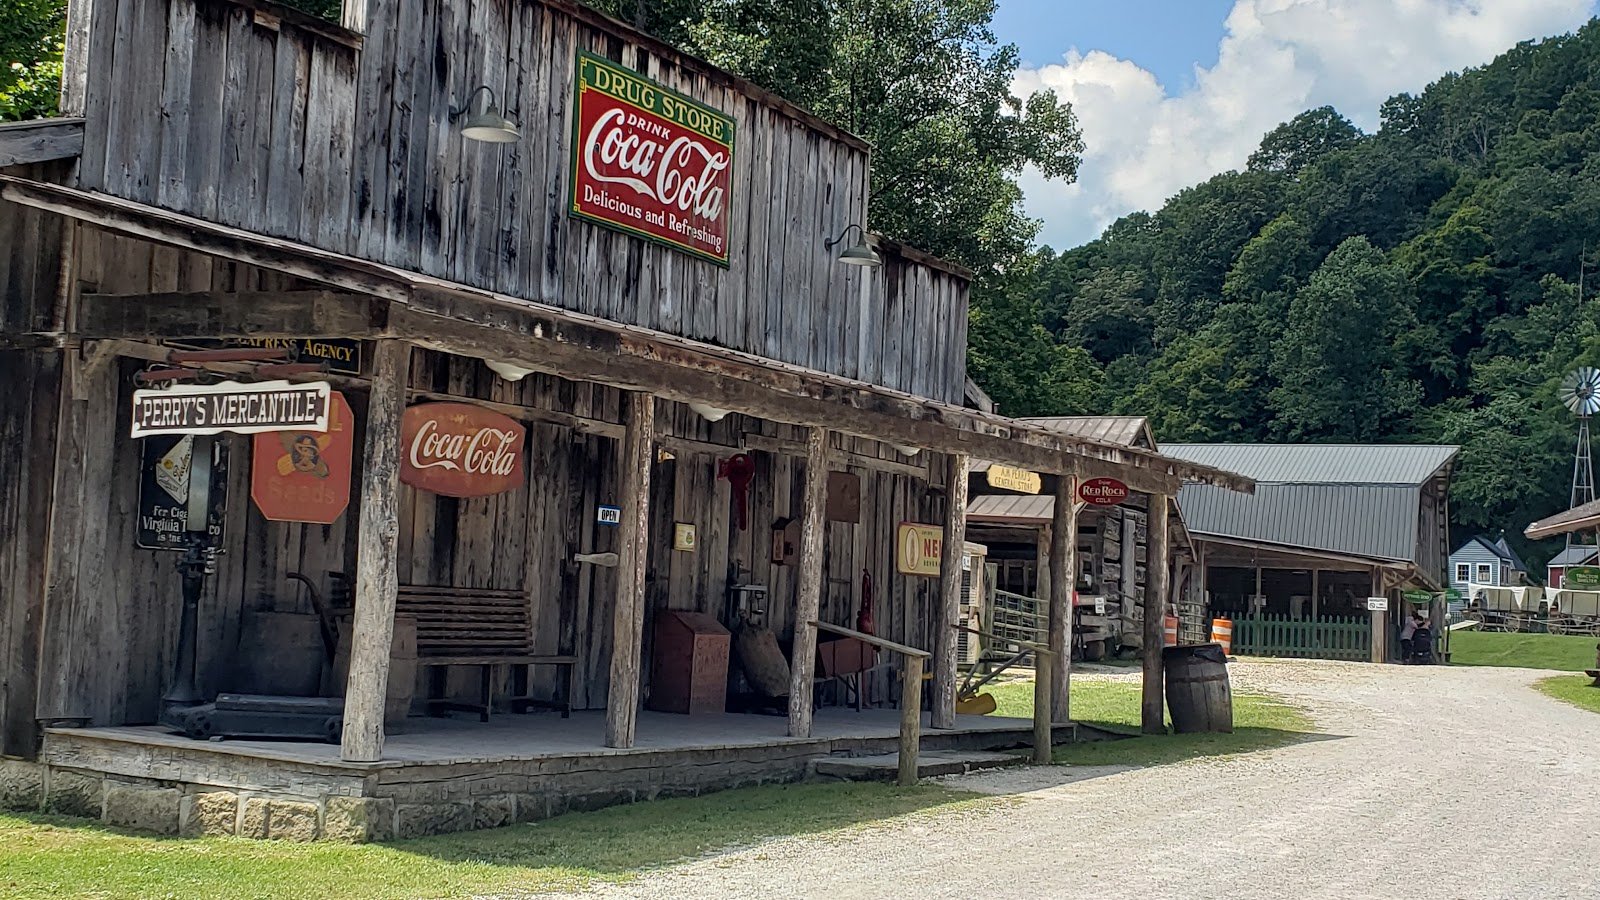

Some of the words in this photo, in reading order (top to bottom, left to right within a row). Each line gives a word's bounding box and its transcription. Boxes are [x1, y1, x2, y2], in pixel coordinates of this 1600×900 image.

[594, 66, 655, 110] DRUG
[663, 97, 725, 140] STORE
[627, 113, 671, 141] DRINK
[584, 108, 730, 222] Coca-Cola
[583, 184, 642, 219] Delicious
[645, 211, 665, 227] and
[668, 213, 723, 254] Refreshing
[301, 338, 354, 362] AGENCY
[141, 396, 207, 427] PERRY'S
[211, 391, 317, 425] MERCANTILE
[409, 419, 519, 476] Coca-Cola
[268, 475, 336, 504] Seeds
[994, 476, 1017, 489] GENERAL
[1017, 480, 1034, 492] STORE
[1082, 485, 1101, 496] RED
[1101, 485, 1126, 497] ROCK
[142, 516, 180, 532] Virginia
[601, 509, 617, 522] OPEN
[157, 532, 166, 542] is
